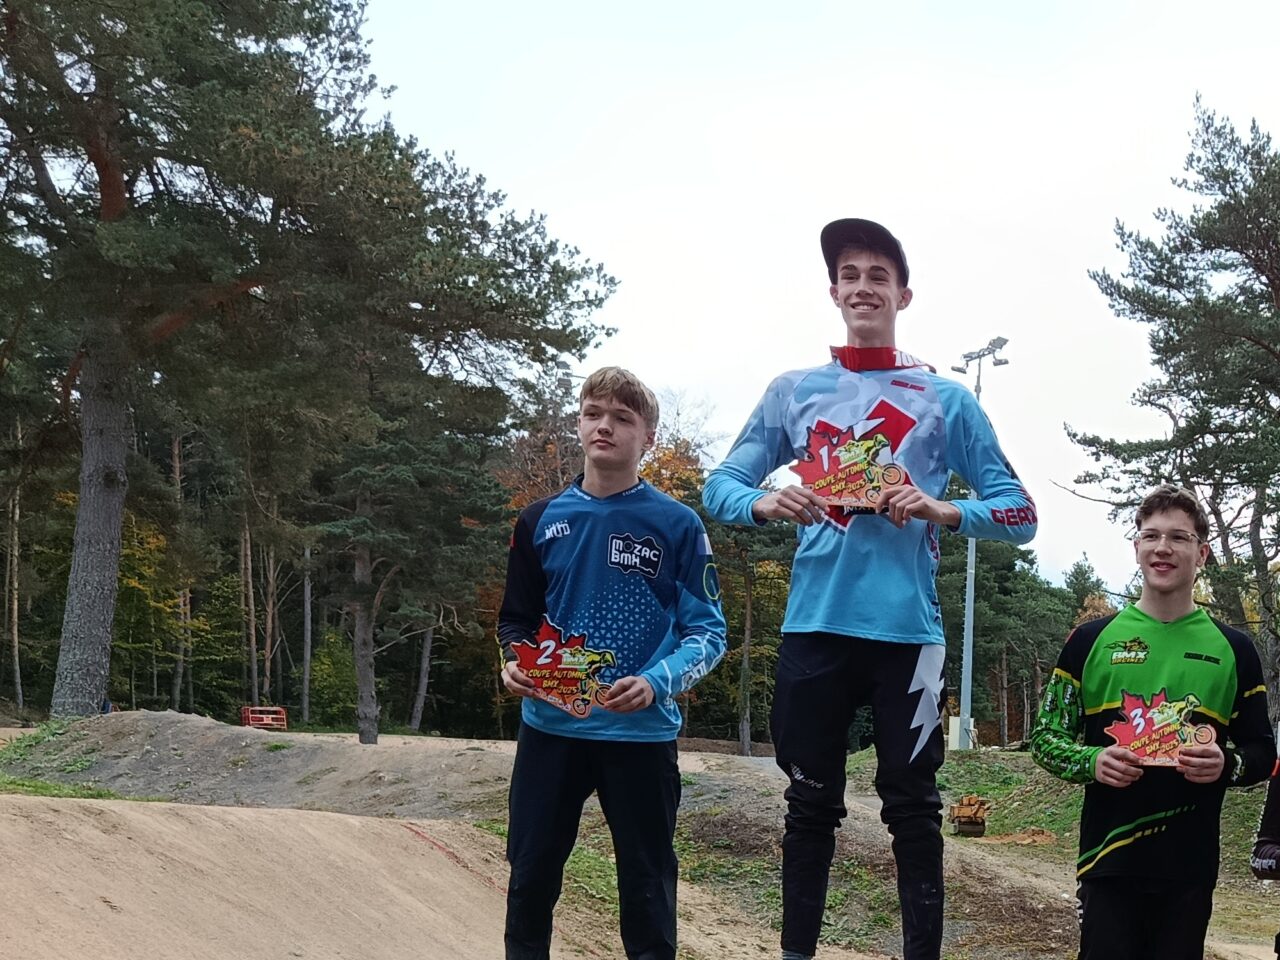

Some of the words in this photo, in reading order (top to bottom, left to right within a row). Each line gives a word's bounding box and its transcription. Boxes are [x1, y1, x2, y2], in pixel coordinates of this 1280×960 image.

[819, 445, 829, 473] 1
[814, 474, 836, 490] COUPE
[838, 463, 869, 481] AUTOMNE
[612, 539, 660, 561] MOZAC
[536, 640, 556, 665] 2
[528, 669, 551, 678] COUPE
[553, 670, 587, 679] AUTOMNE
[542, 680, 560, 688] BMX
[1130, 707, 1146, 736] 3
[1130, 735, 1150, 751] COUPE
[1152, 723, 1182, 740] AUTOMNE
